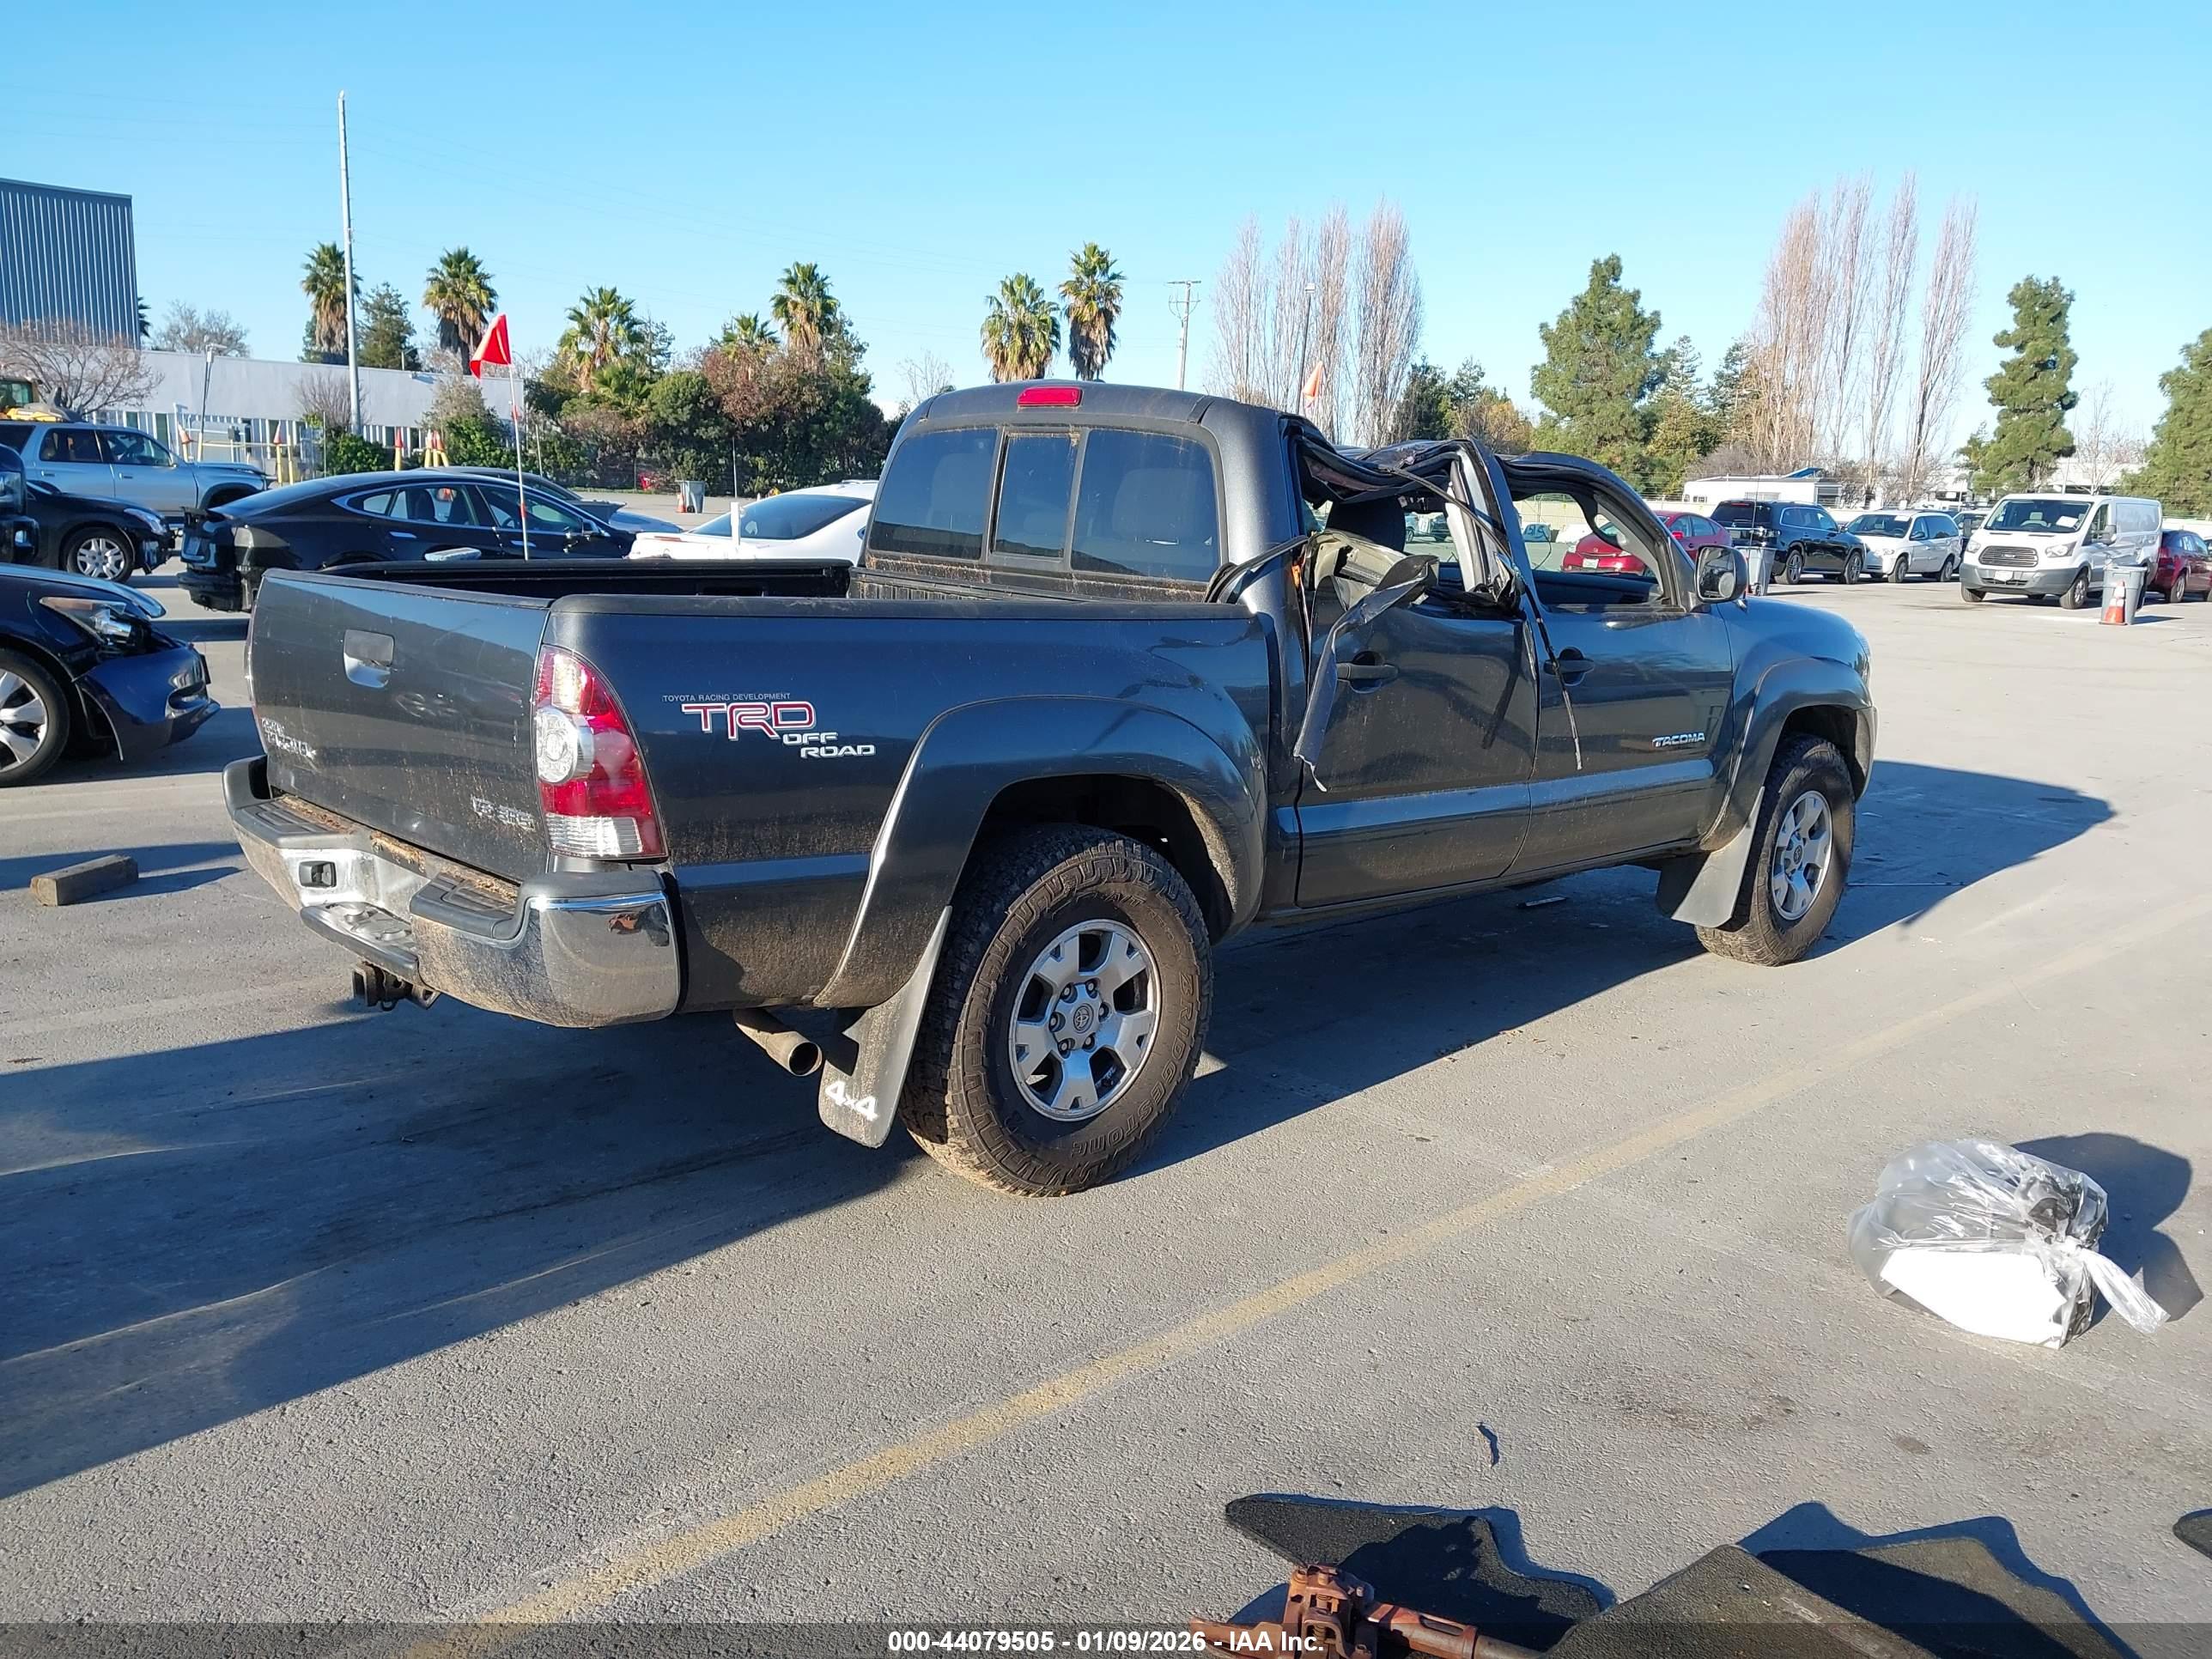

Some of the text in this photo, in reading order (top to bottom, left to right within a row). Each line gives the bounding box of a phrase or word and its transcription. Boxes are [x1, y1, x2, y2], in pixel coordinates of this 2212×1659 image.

[662, 692, 791, 702] TOYOTA RACING DEVELOPMENT
[682, 701, 817, 741] TRD
[782, 732, 838, 746] OFF
[1652, 732, 1705, 747] TACOMA
[799, 744, 876, 758] ROAD
[1068, 972, 1197, 1157] BRIDGESTONE
